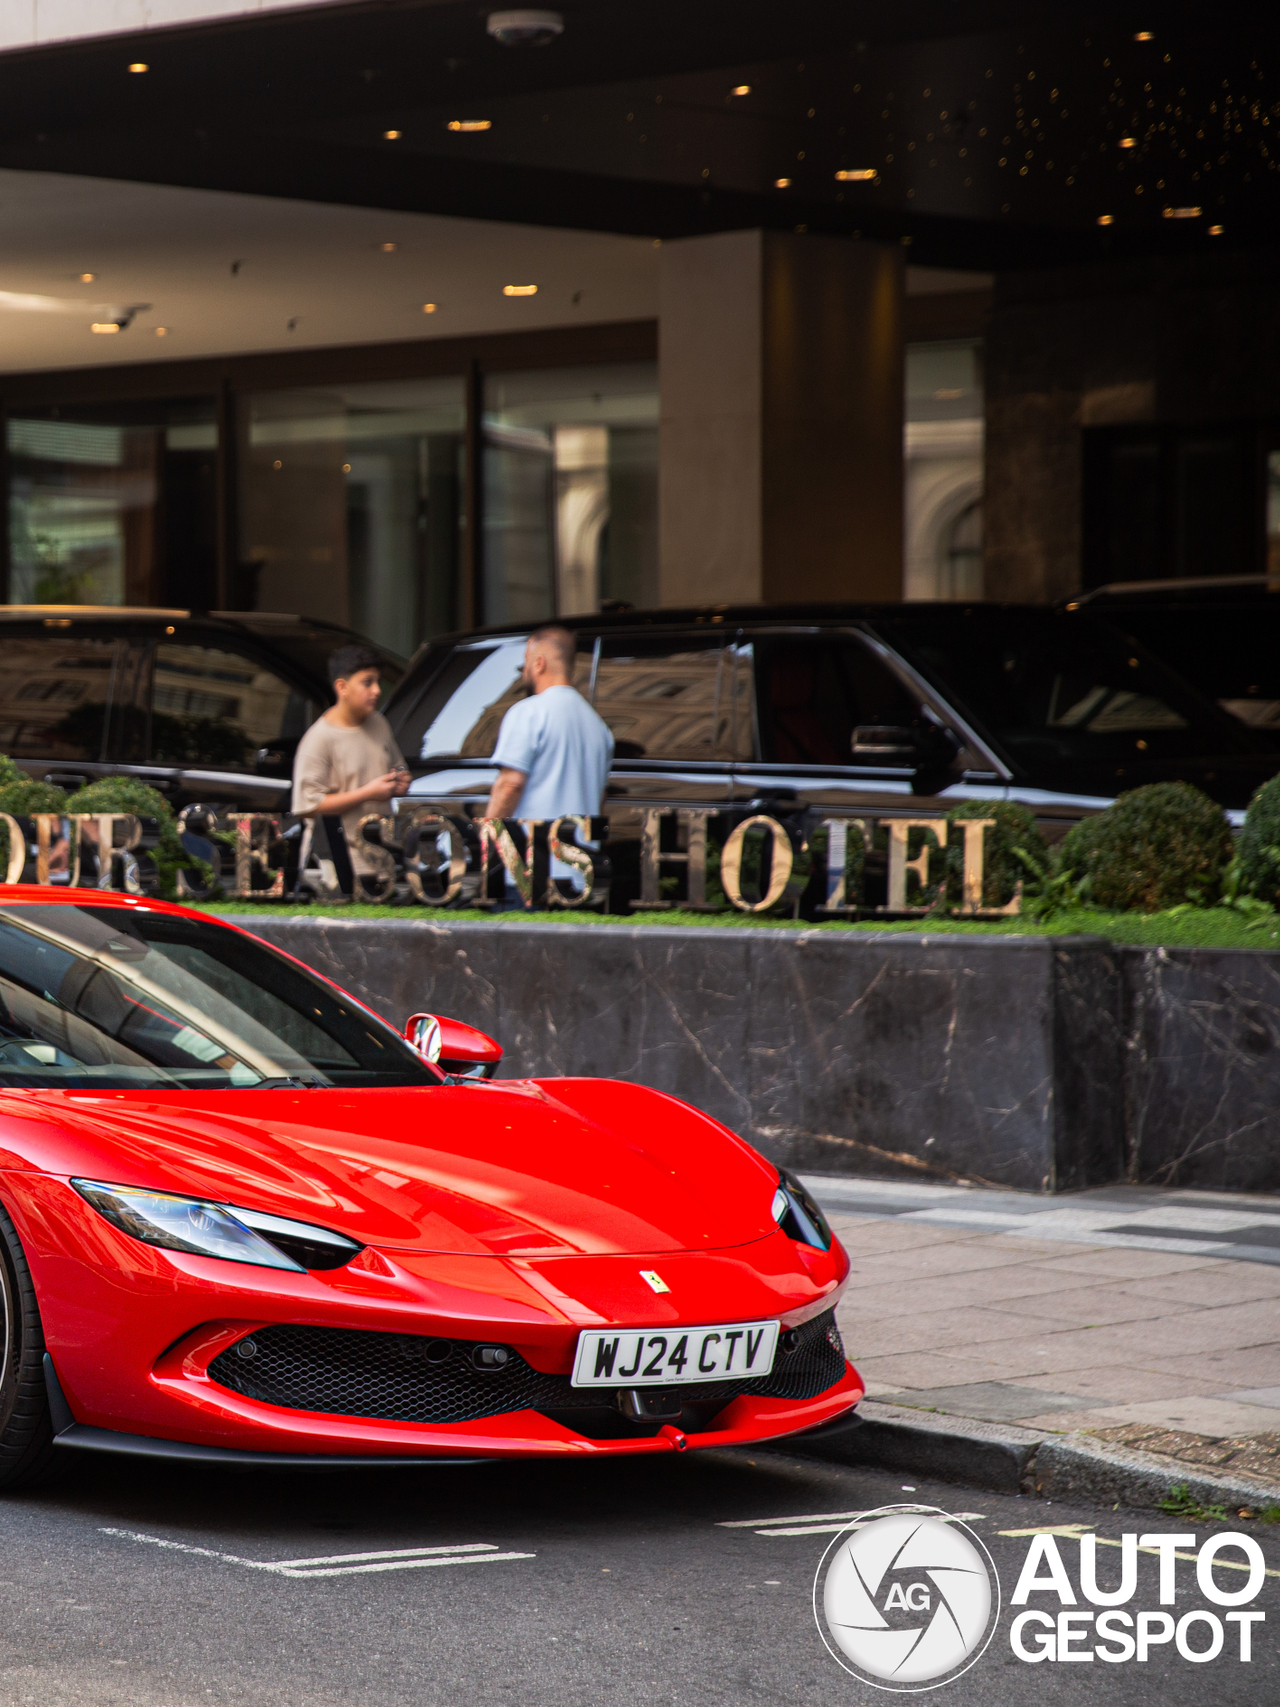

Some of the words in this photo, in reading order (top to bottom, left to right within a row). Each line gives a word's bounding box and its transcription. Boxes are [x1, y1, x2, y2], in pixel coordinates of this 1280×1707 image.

[177, 803, 600, 908] SEASONS
[629, 807, 1022, 914] HOTEL
[593, 1335, 689, 1378] WJ24
[698, 1329, 765, 1373] CTV
